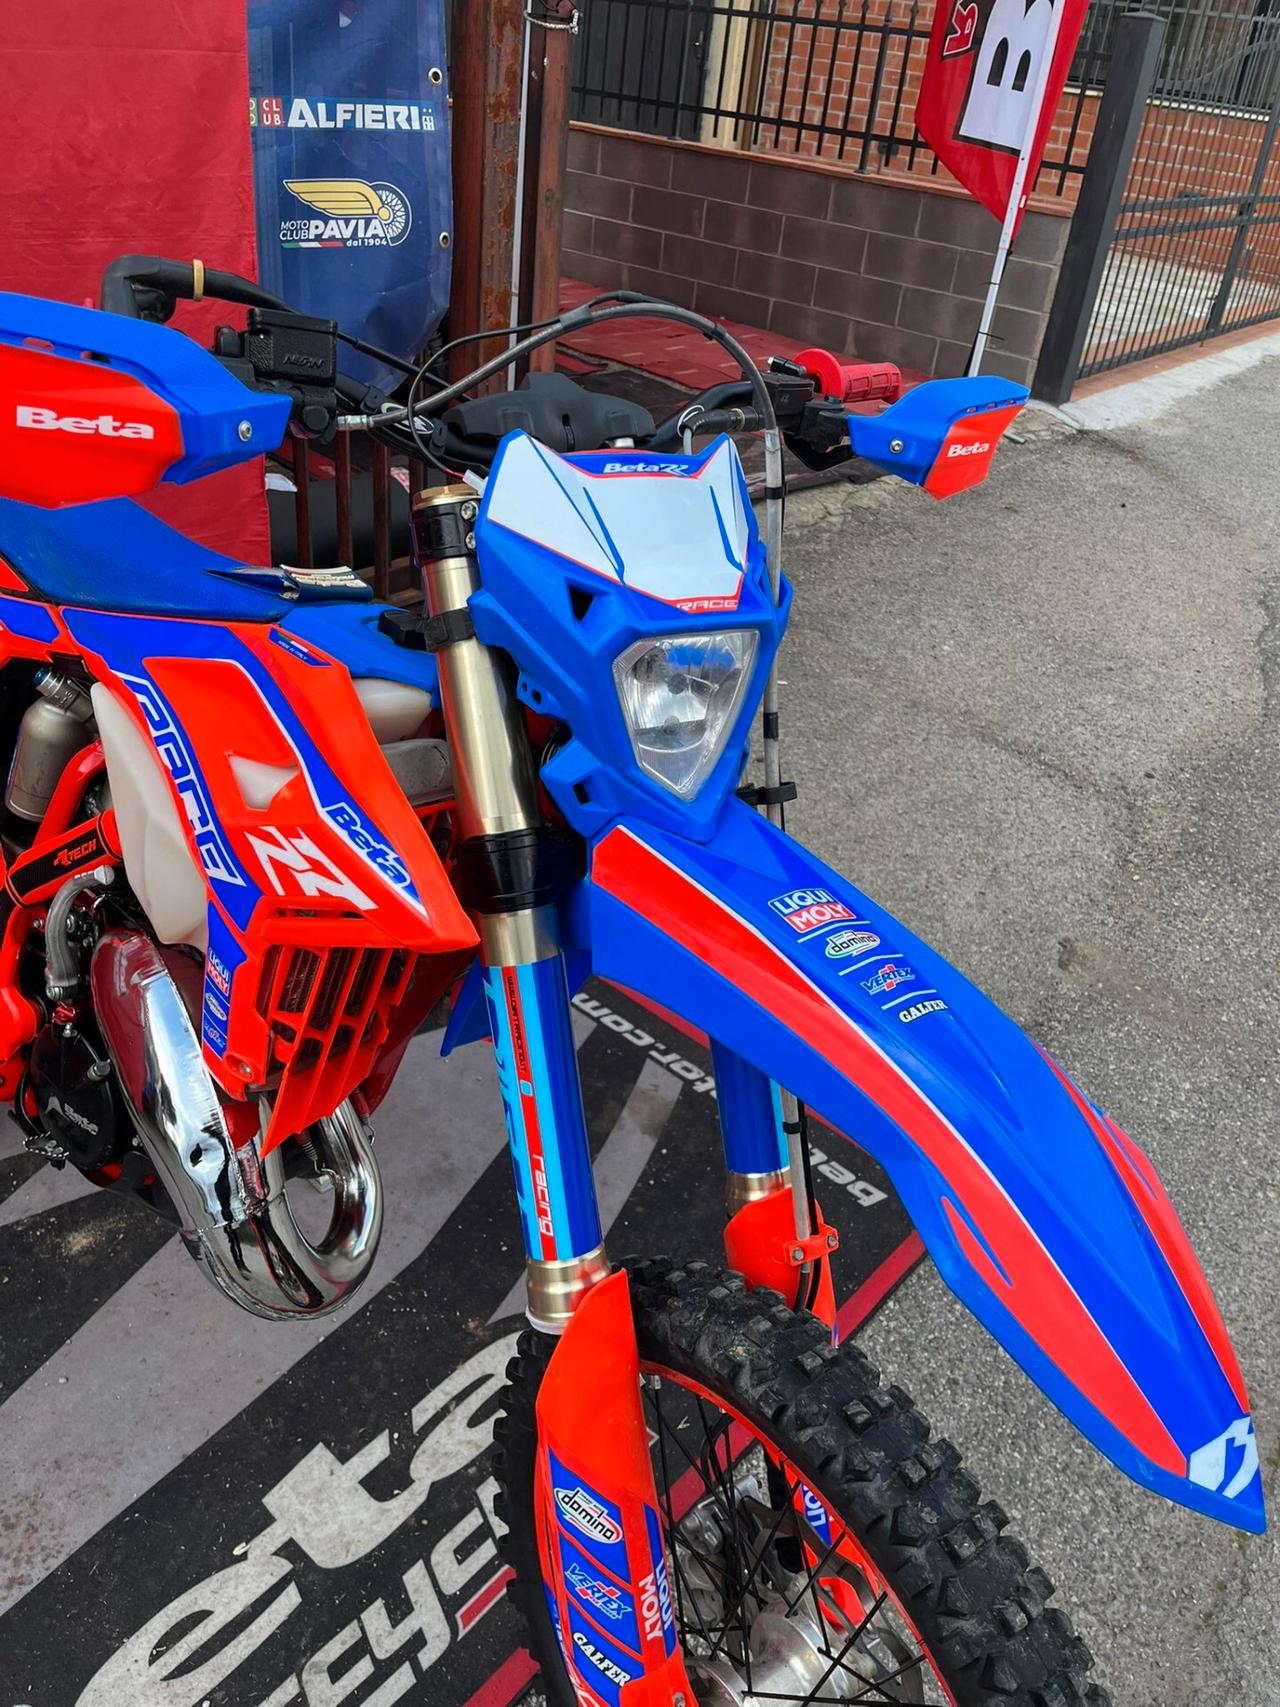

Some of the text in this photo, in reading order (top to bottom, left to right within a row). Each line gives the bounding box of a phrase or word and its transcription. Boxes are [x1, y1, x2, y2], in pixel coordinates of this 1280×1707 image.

[287, 98, 420, 130] ALFIERI
[279, 230, 309, 241] CLUB
[281, 221, 309, 230] MOTO
[309, 219, 386, 239] PAVIA
[346, 237, 387, 247] dal 1904
[16, 404, 155, 440] Beta
[946, 441, 991, 458] Beta
[675, 599, 739, 610] RACE
[323, 803, 411, 889] Beta
[773, 888, 834, 915] LIQUI
[790, 903, 851, 930] MOLY
[830, 932, 877, 954] domino
[861, 967, 914, 992] VERTEX
[898, 999, 948, 1023] GALFER
[561, 1489, 615, 1541] domino
[566, 1562, 632, 1618] VERTEX
[655, 1558, 673, 1631] LIQUI
[638, 1571, 664, 1641] MOLY
[572, 1631, 632, 1687] GALFER
